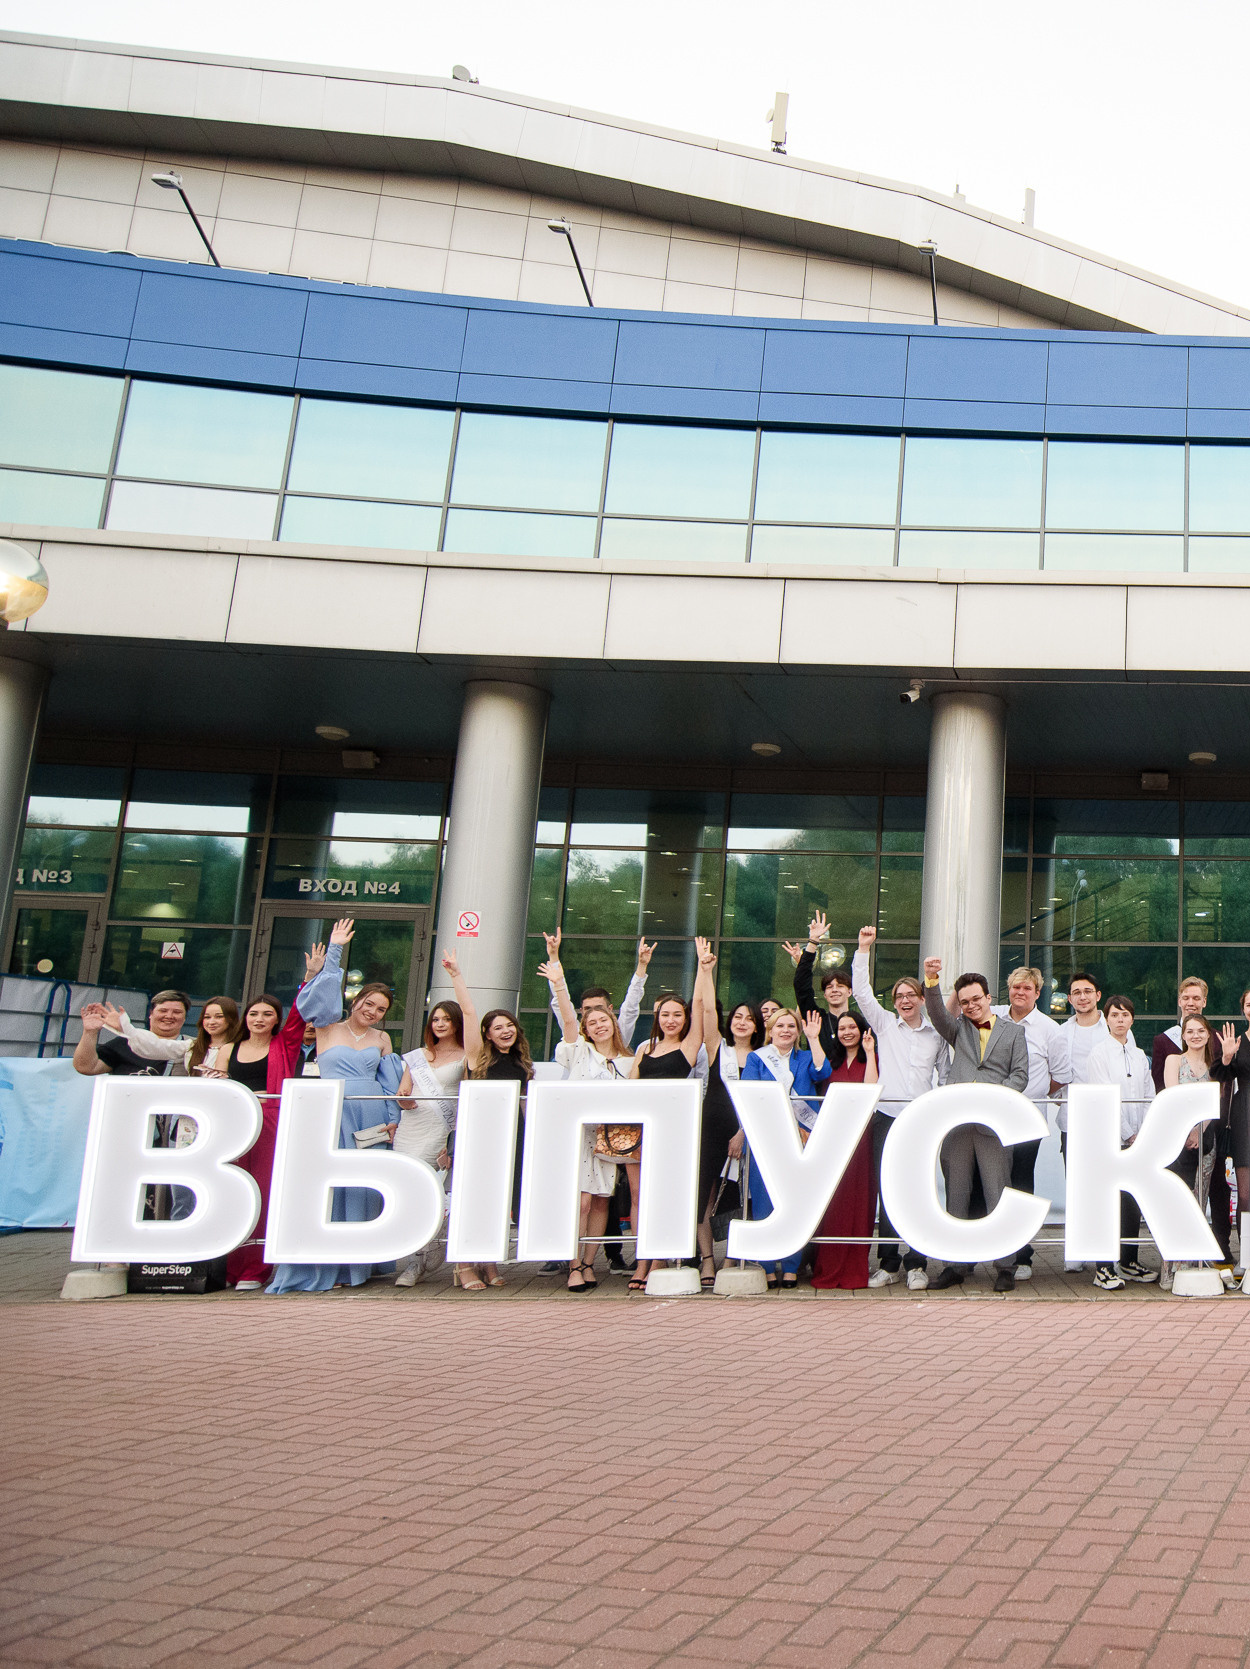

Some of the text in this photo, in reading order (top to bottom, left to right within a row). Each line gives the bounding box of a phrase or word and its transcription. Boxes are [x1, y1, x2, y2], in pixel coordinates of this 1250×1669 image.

[32, 868, 72, 884] №3
[299, 879, 400, 896] ВХОД №4
[141, 1264, 192, 1276] SuperStep
